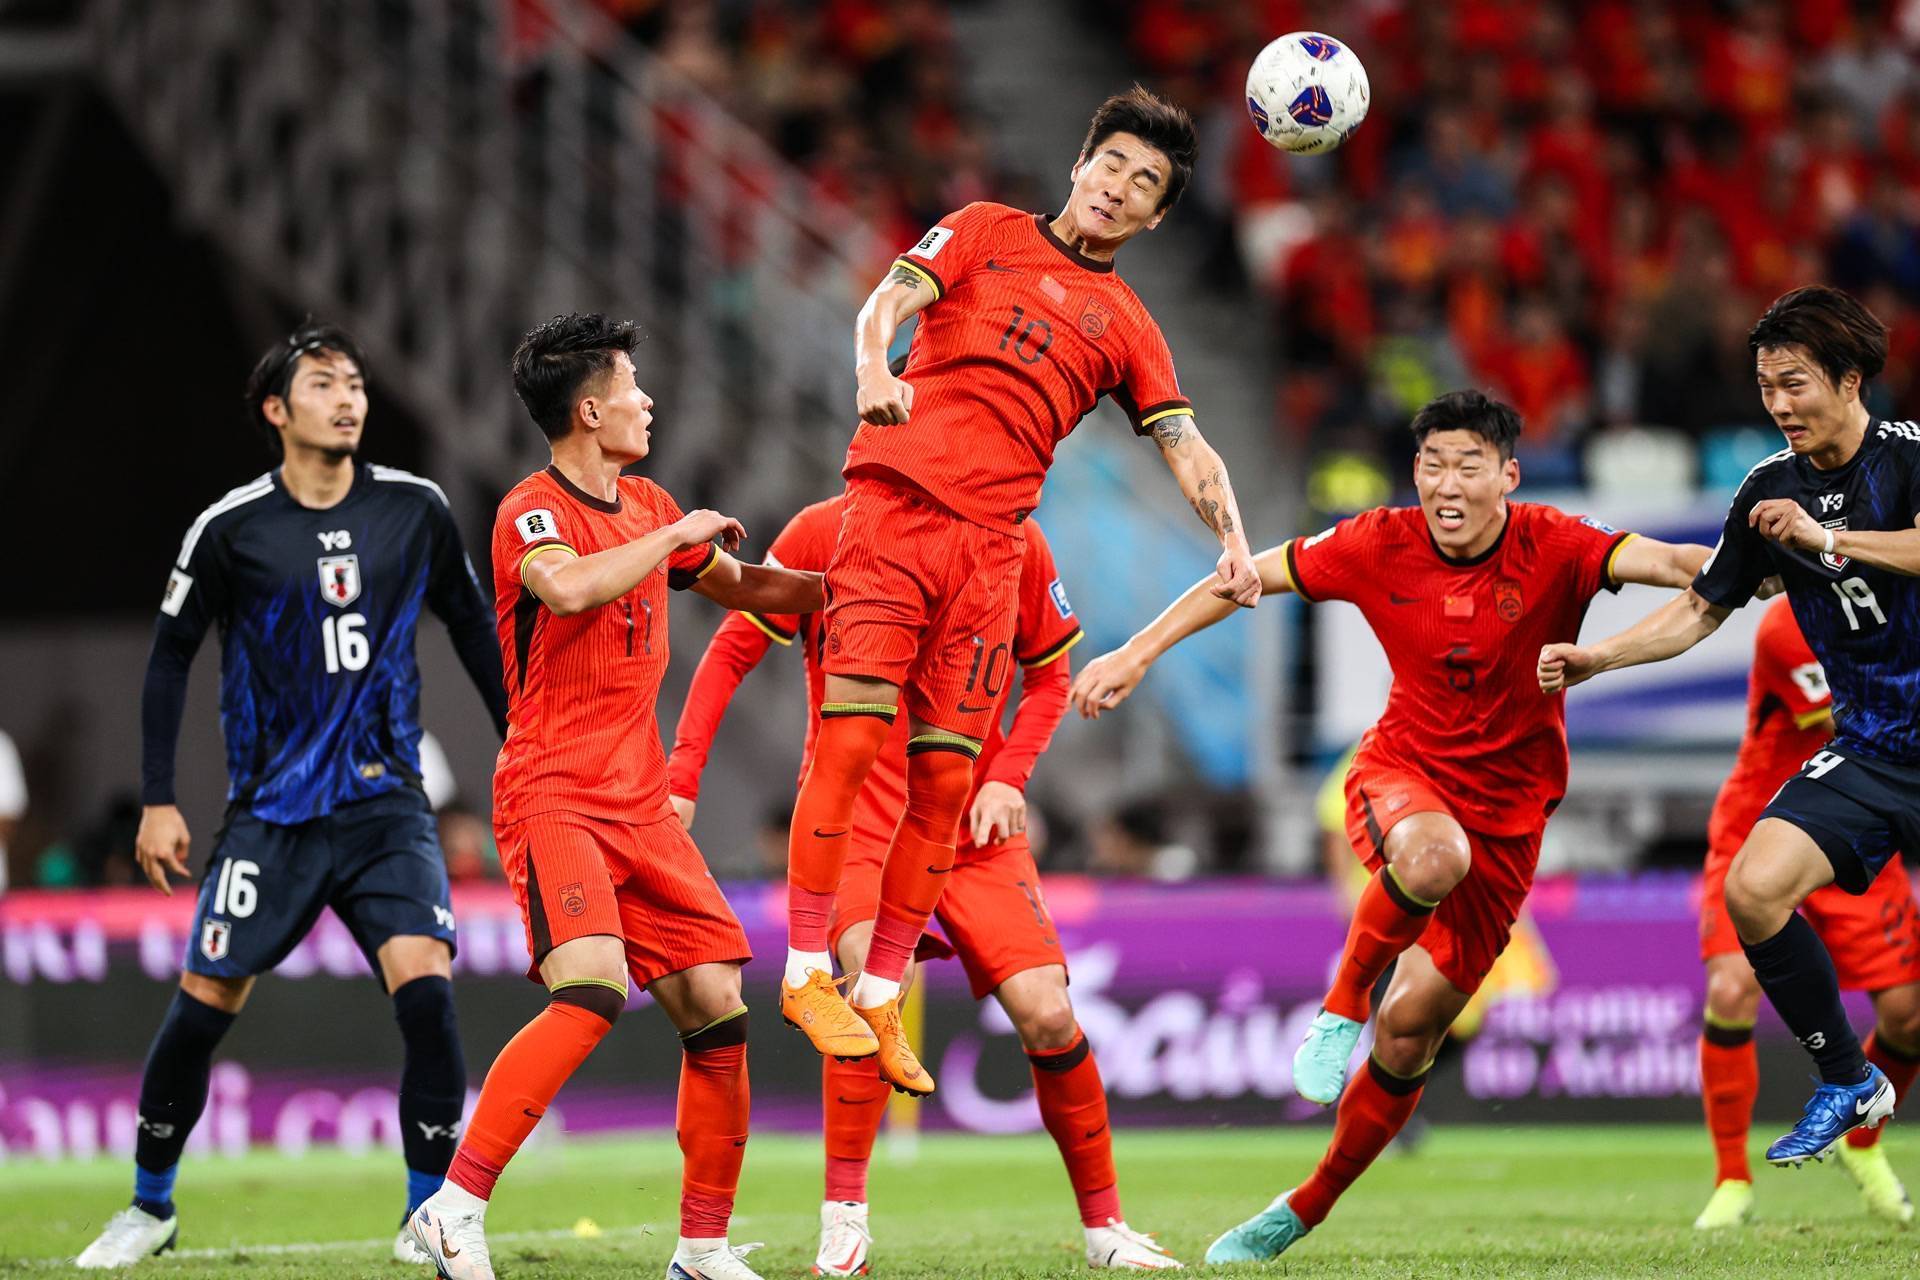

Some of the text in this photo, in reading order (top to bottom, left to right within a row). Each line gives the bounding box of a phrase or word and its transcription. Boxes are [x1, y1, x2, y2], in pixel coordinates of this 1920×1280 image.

[999, 305, 1053, 364] 10
[1819, 493, 1845, 513] Y-3
[623, 599, 652, 657] 11
[1831, 577, 1888, 631] 19
[322, 612, 370, 674] 16
[966, 636, 1008, 698] 10
[1446, 646, 1475, 692] 5
[1801, 750, 1846, 779] 9
[214, 857, 261, 919] 16
